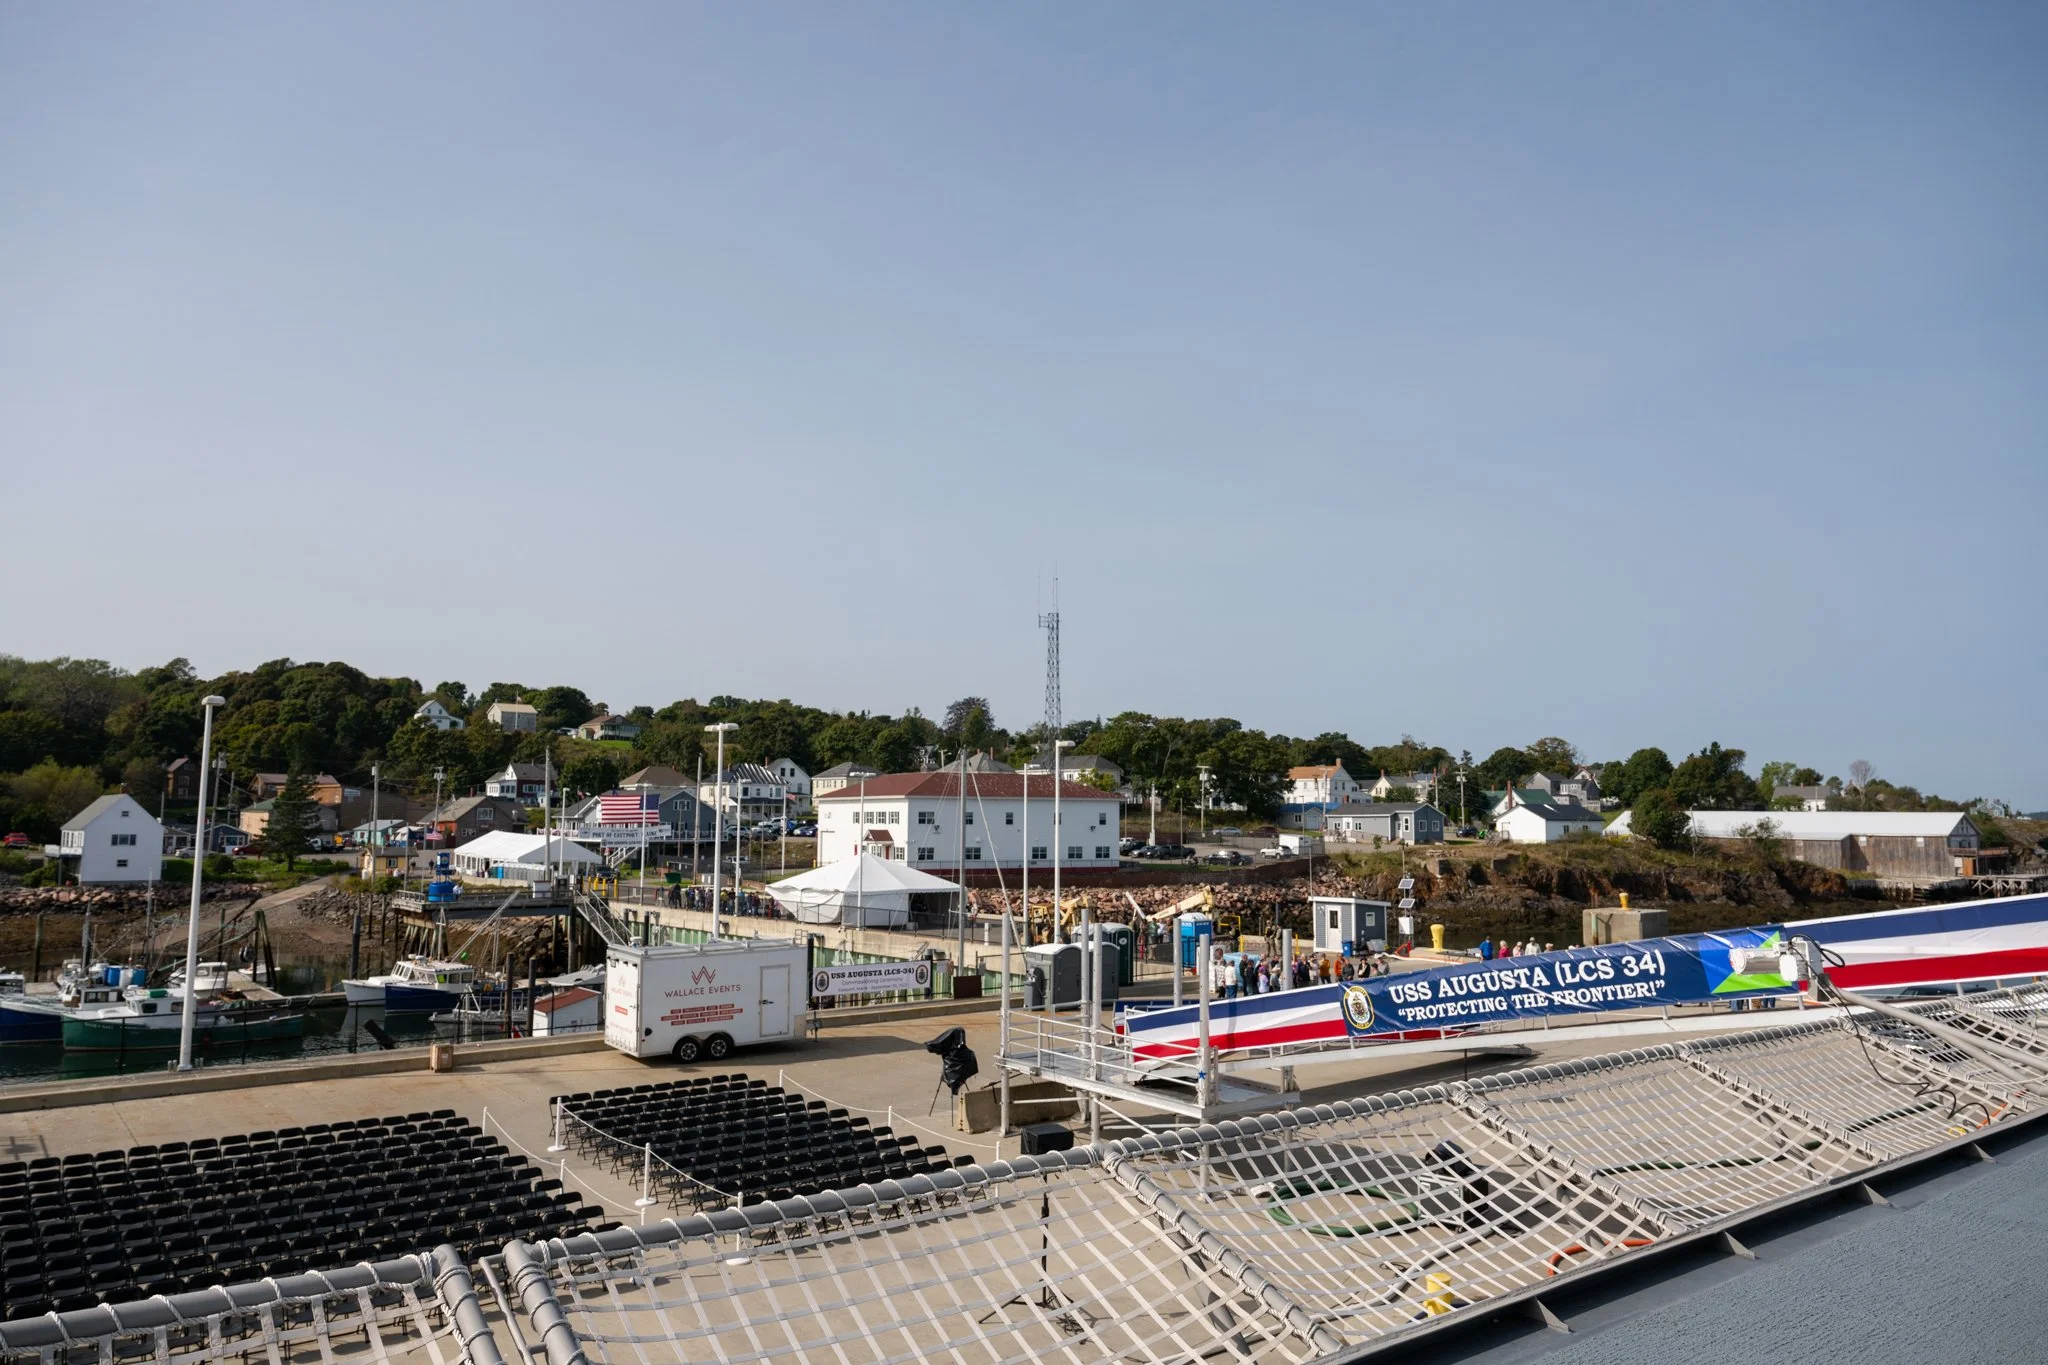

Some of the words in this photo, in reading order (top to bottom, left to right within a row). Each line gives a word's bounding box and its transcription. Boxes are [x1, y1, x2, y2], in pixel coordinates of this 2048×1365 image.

[847, 969, 883, 979] AUGUSTA
[884, 967, 915, 977] (LCS-34)
[1388, 981, 1433, 1004] USS
[1438, 966, 1551, 998] AUGUSTA
[1554, 958, 1615, 987] (LCS
[1621, 949, 1666, 977] 34)
[664, 987, 705, 998] WALLACE
[708, 984, 742, 994] EVENTS
[1511, 993, 1549, 1009] THE
